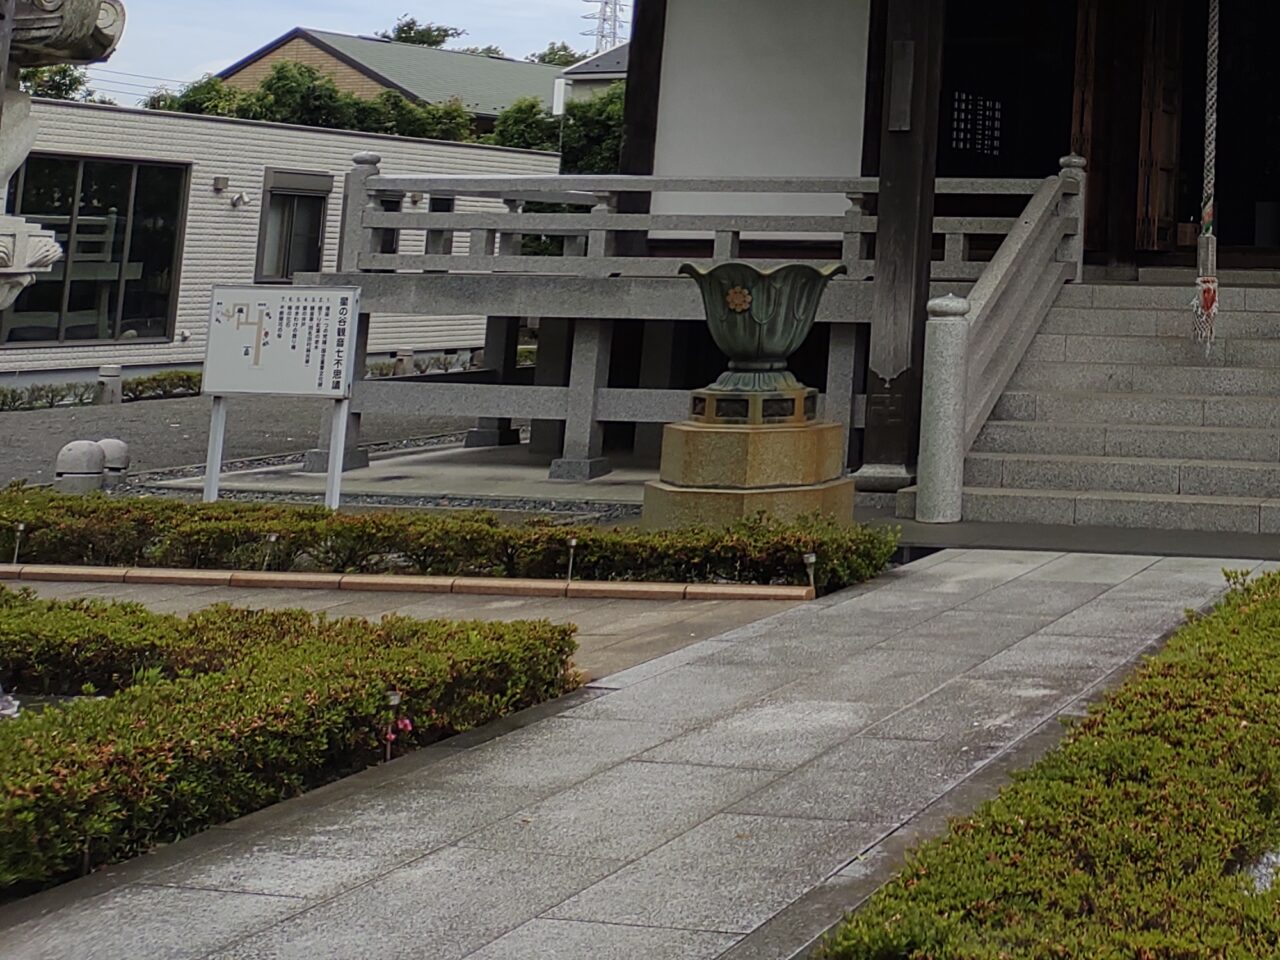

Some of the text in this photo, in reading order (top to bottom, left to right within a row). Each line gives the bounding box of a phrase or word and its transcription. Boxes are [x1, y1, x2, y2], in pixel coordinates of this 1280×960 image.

[331, 296, 349, 390] 星の谷観音七不思議
